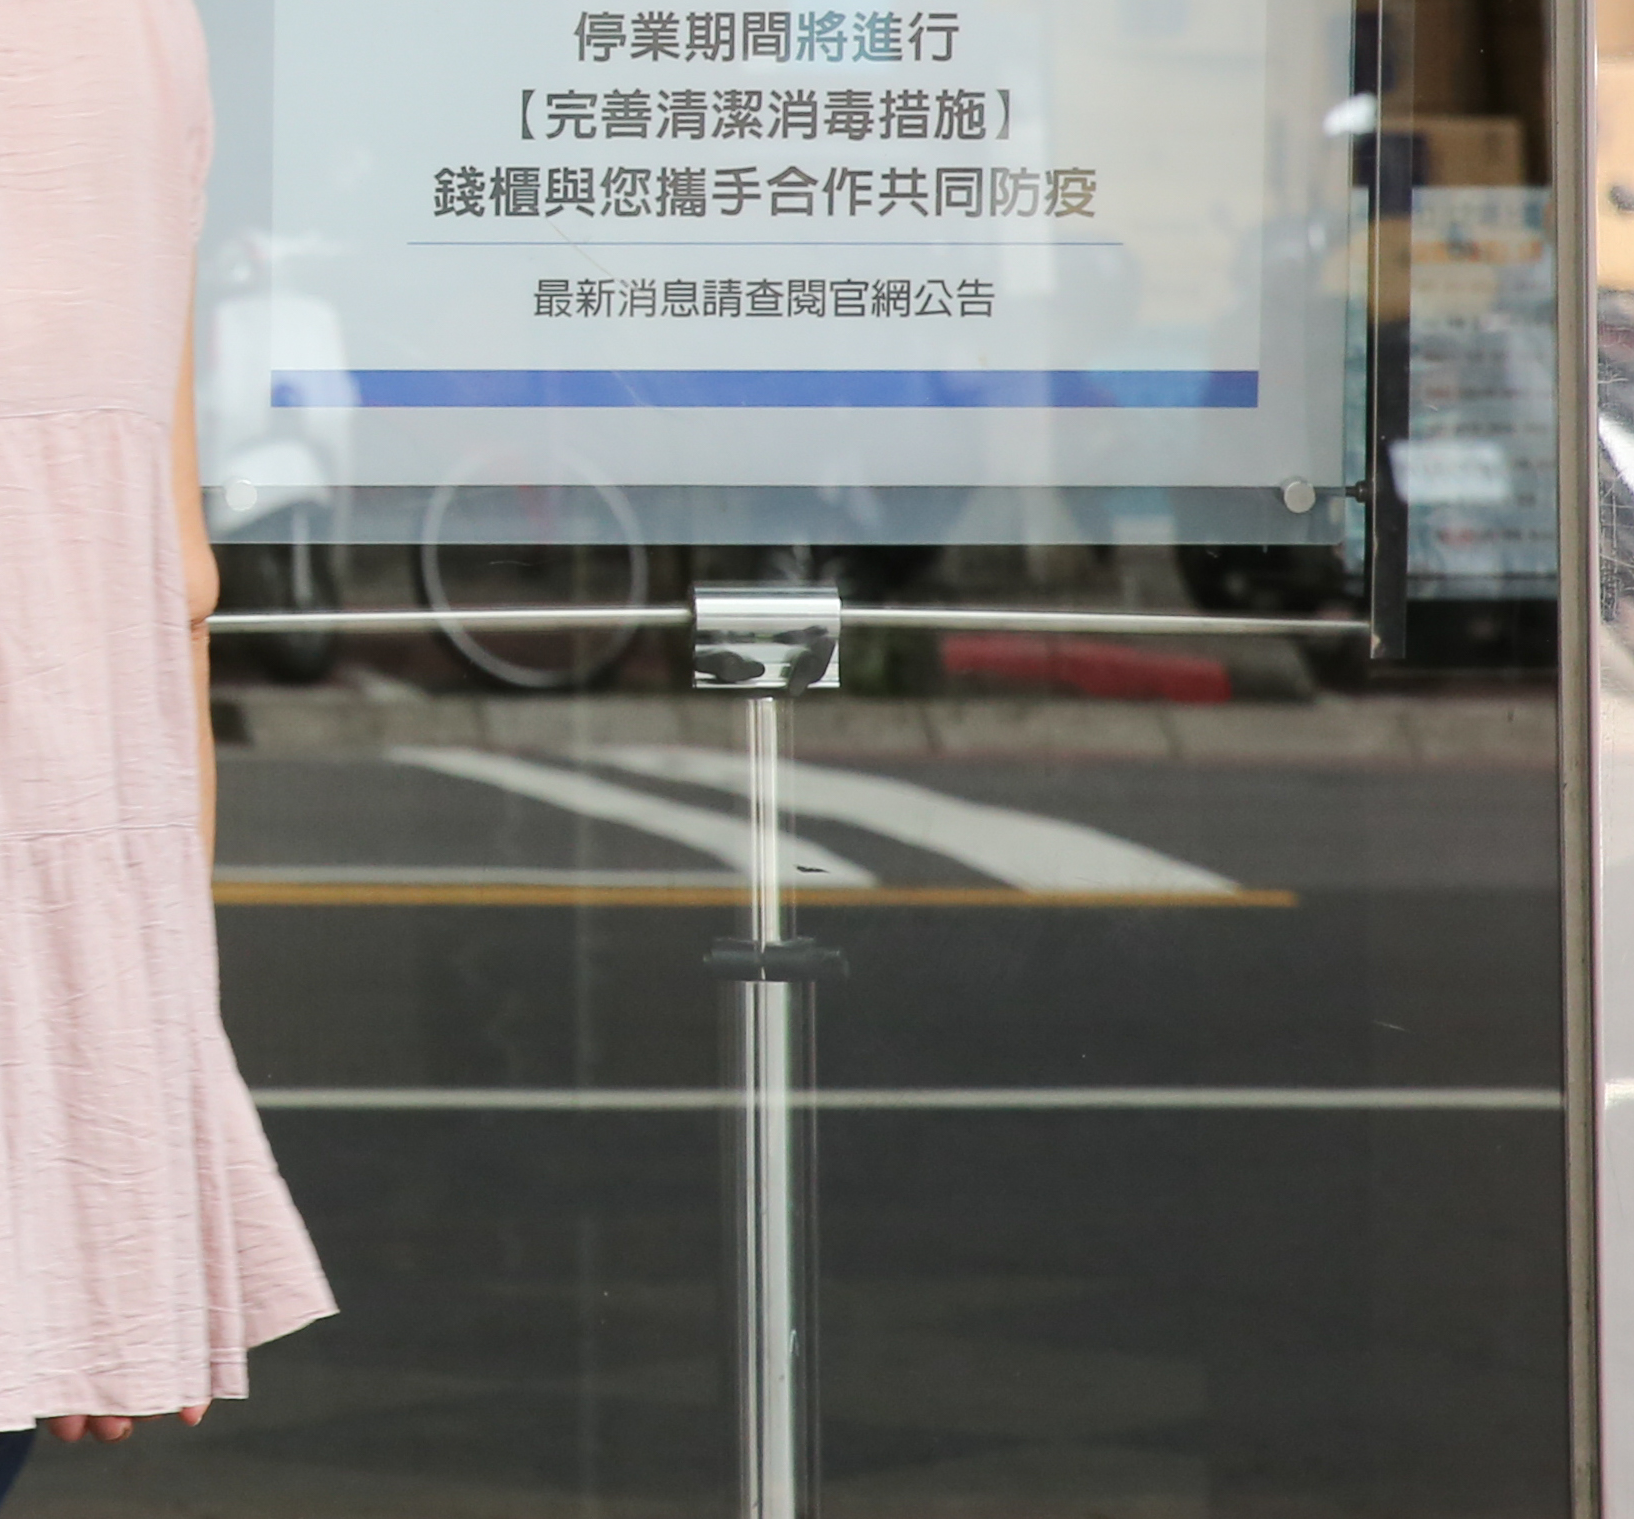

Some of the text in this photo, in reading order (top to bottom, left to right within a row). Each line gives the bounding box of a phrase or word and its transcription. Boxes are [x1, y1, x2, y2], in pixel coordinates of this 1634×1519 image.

[574, 11, 959, 64] 停業期間將進行
[520, 89, 1011, 141] 【完善清潔消毒措施】
[433, 166, 1096, 220] 錢櫃與您攜手合作共同防疫
[533, 280, 995, 320] 最新消息請查閱官網公告
